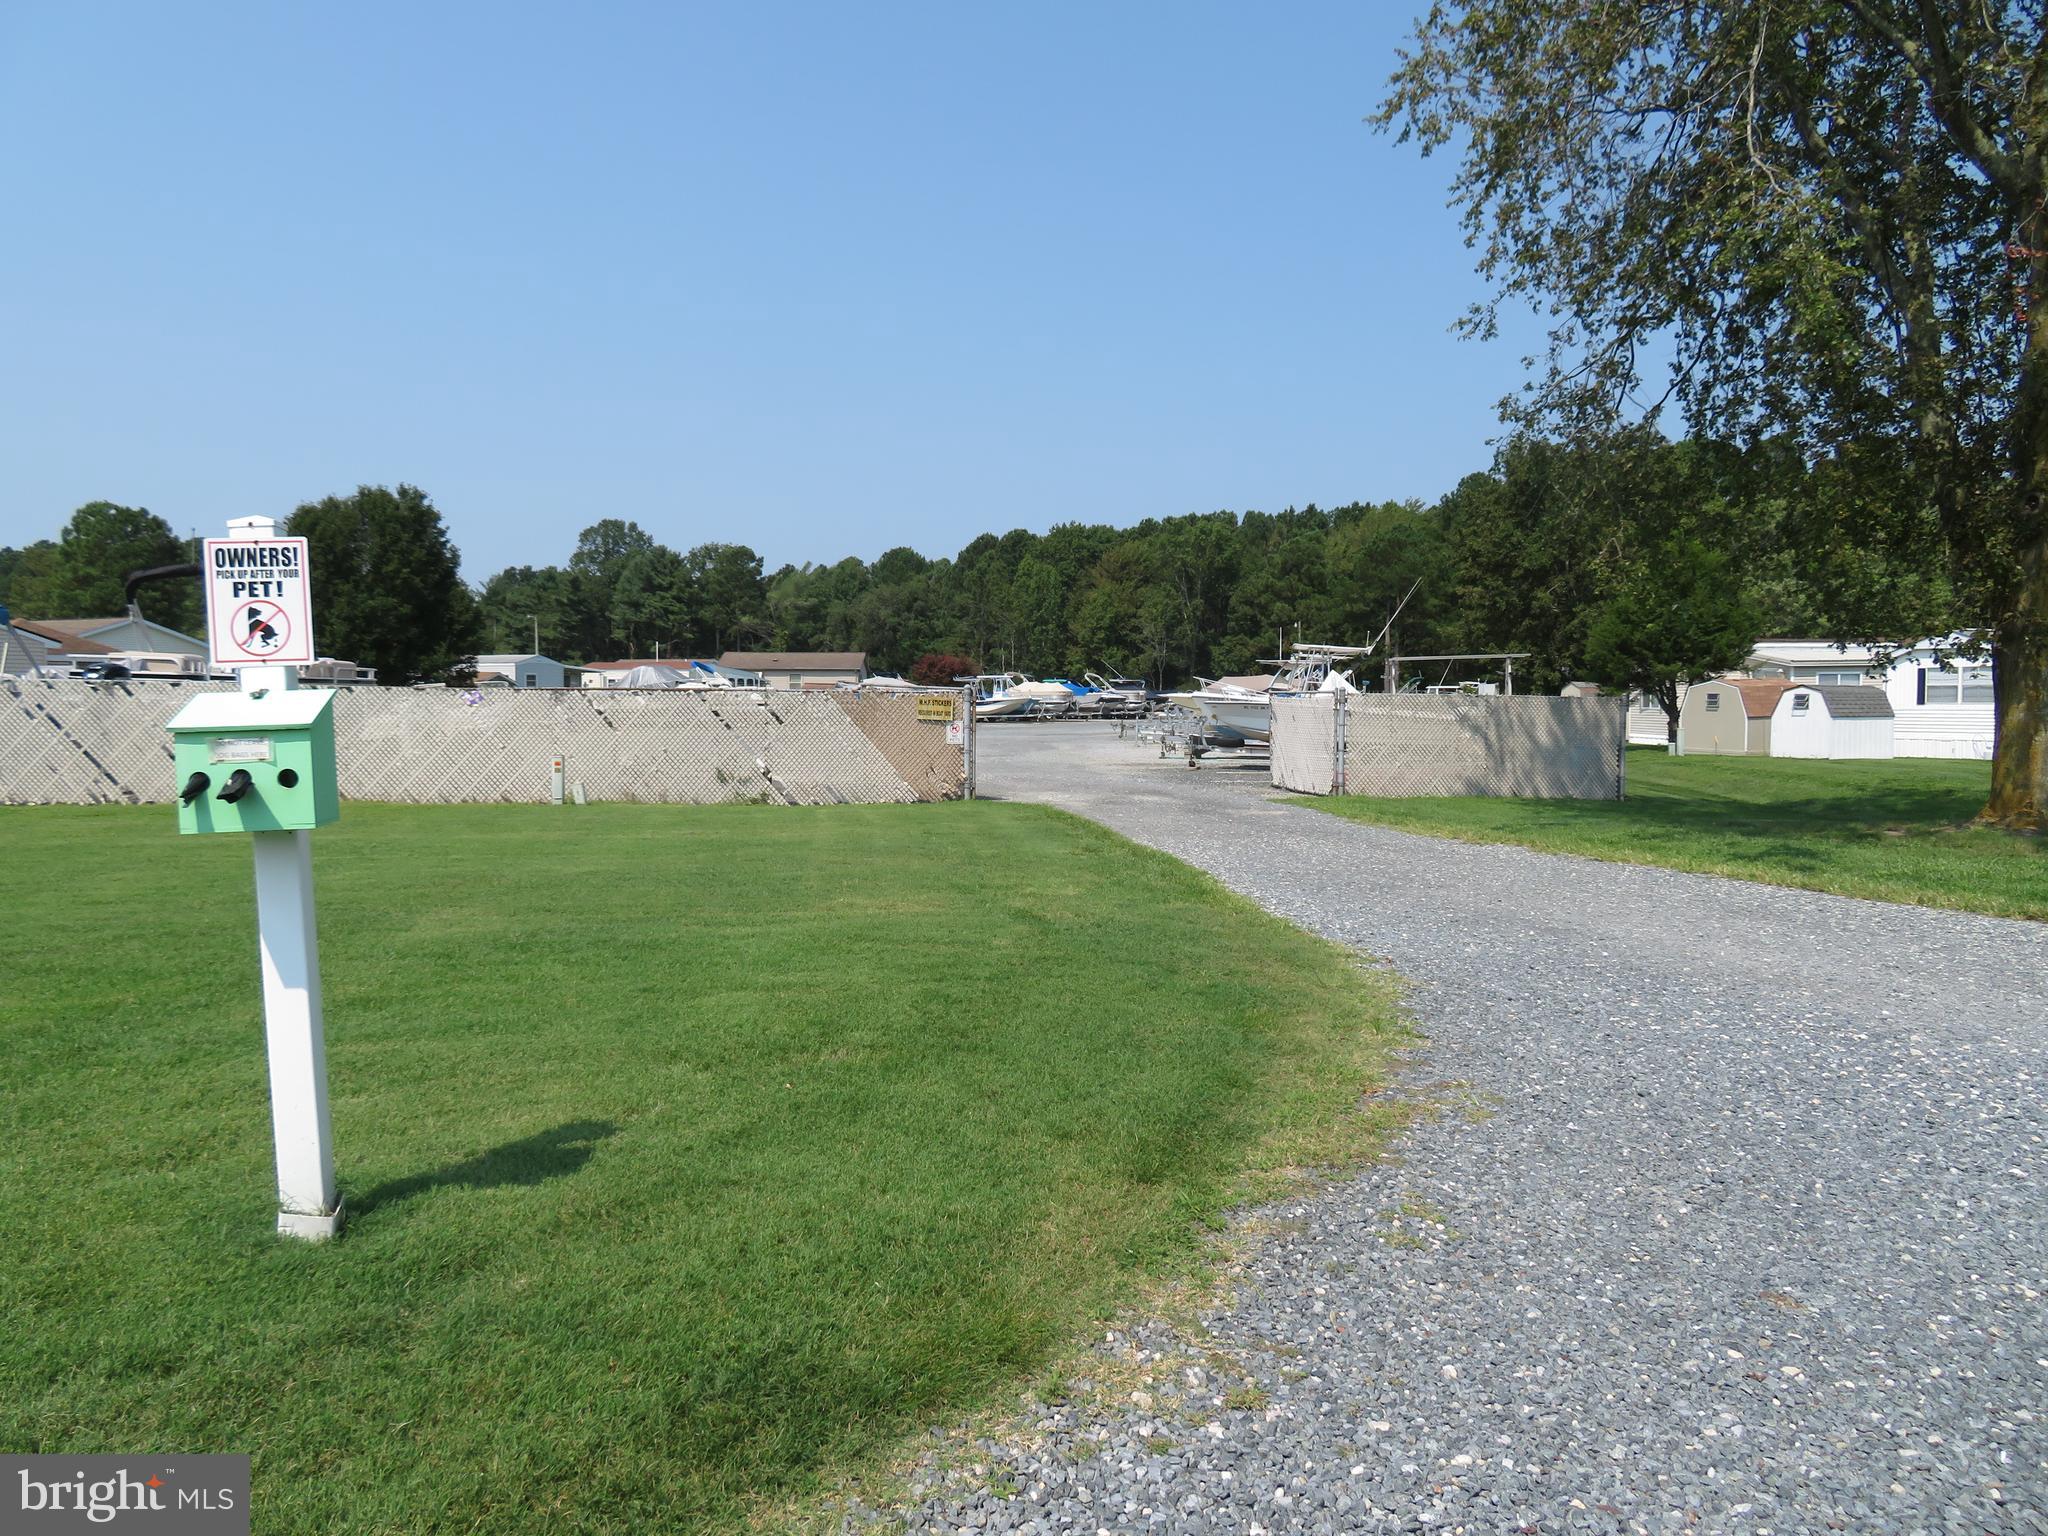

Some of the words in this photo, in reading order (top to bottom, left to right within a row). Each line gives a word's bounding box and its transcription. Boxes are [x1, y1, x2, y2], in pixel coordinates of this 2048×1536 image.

[215, 547, 298, 568] OWNERS!
[216, 569, 236, 579] PICK
[238, 569, 247, 579] UP
[250, 569, 274, 579] AFTER
[278, 569, 299, 578] YOUR
[233, 581, 283, 598] PET!
